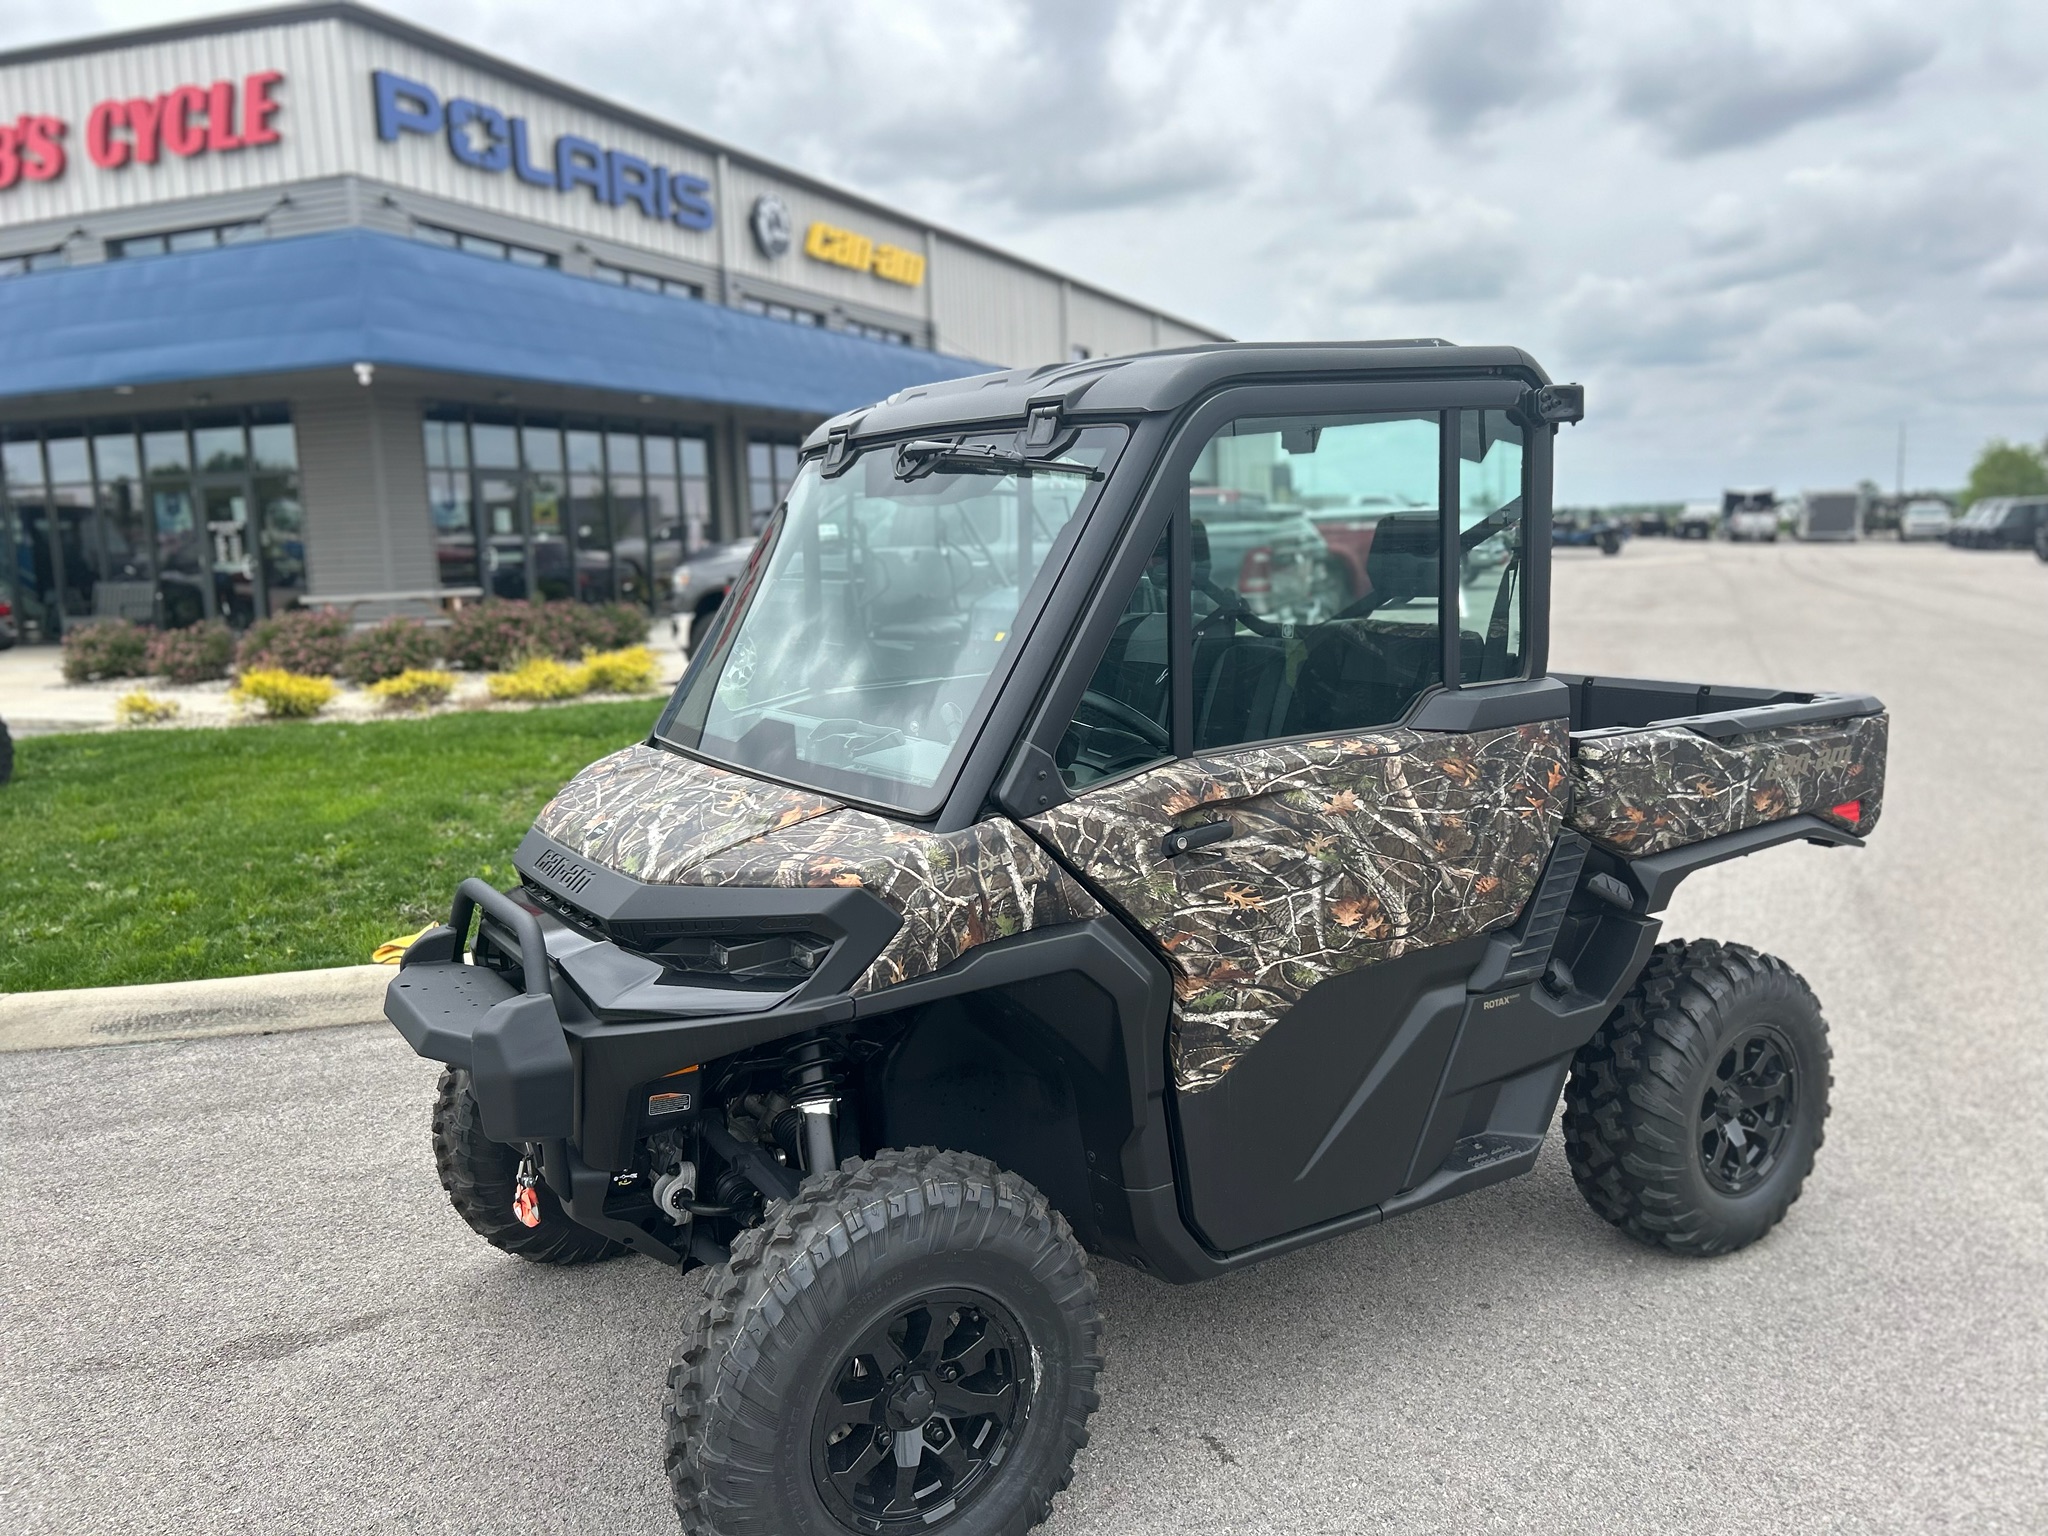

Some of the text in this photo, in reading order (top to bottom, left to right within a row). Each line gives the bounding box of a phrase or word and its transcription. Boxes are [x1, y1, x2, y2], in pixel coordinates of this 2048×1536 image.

[87, 73, 283, 170] CYCLE
[374, 69, 714, 232] POLARIS
[806, 221, 926, 287] can-am
[534, 849, 596, 894] can-am
[1483, 996, 1510, 1010] ROTAX
